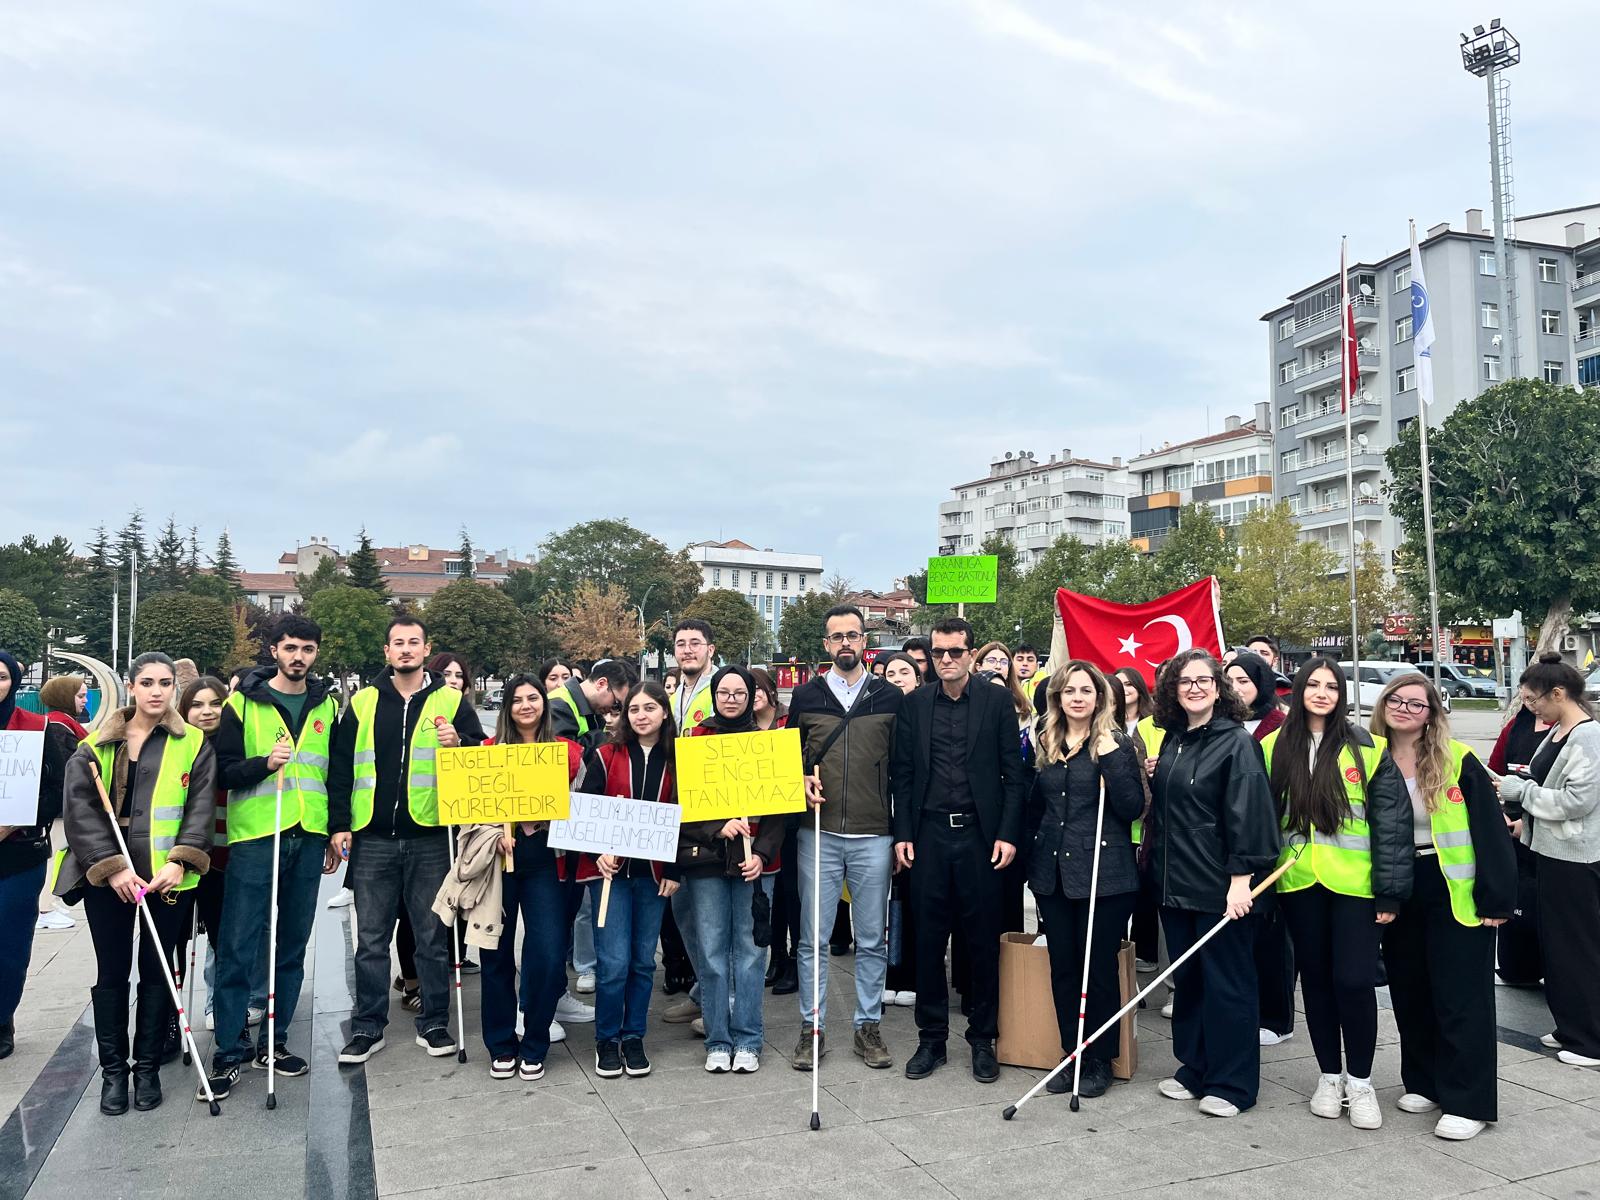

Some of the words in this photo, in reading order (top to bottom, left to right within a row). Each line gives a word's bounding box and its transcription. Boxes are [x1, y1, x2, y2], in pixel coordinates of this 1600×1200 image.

[929, 571, 955, 582] BEYAZ
[703, 759, 788, 784] ENGEL
[682, 781, 802, 808] TANIMAZ
[639, 804, 681, 828] ENGEL
